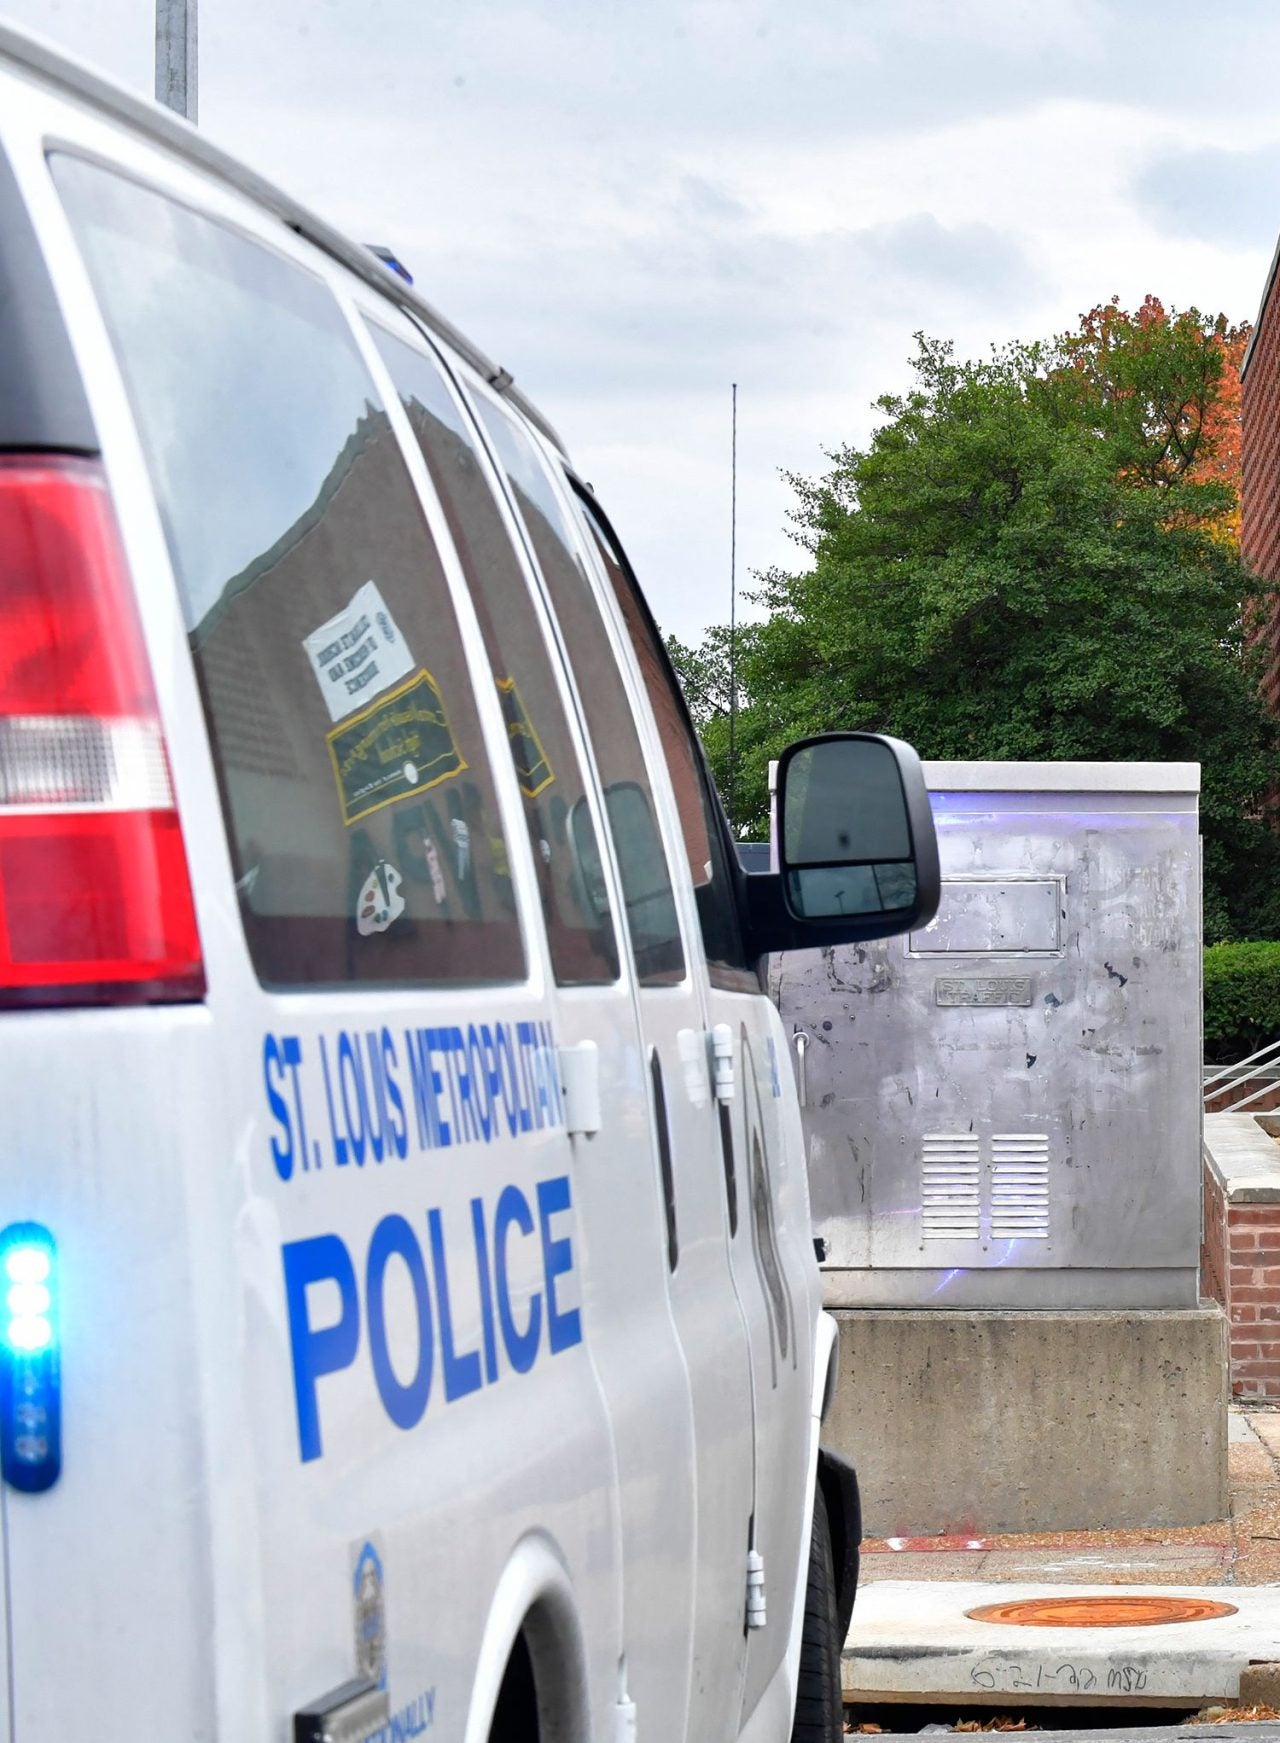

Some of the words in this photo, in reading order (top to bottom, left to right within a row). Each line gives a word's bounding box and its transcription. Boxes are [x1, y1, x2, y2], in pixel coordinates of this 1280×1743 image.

[976, 980, 1026, 992] LOUIS
[263, 1032, 322, 1182] ST.
[319, 1025, 408, 1166] LOUIS
[405, 1020, 564, 1152] METROPOLITAN
[281, 1175, 583, 1465] POLICE
